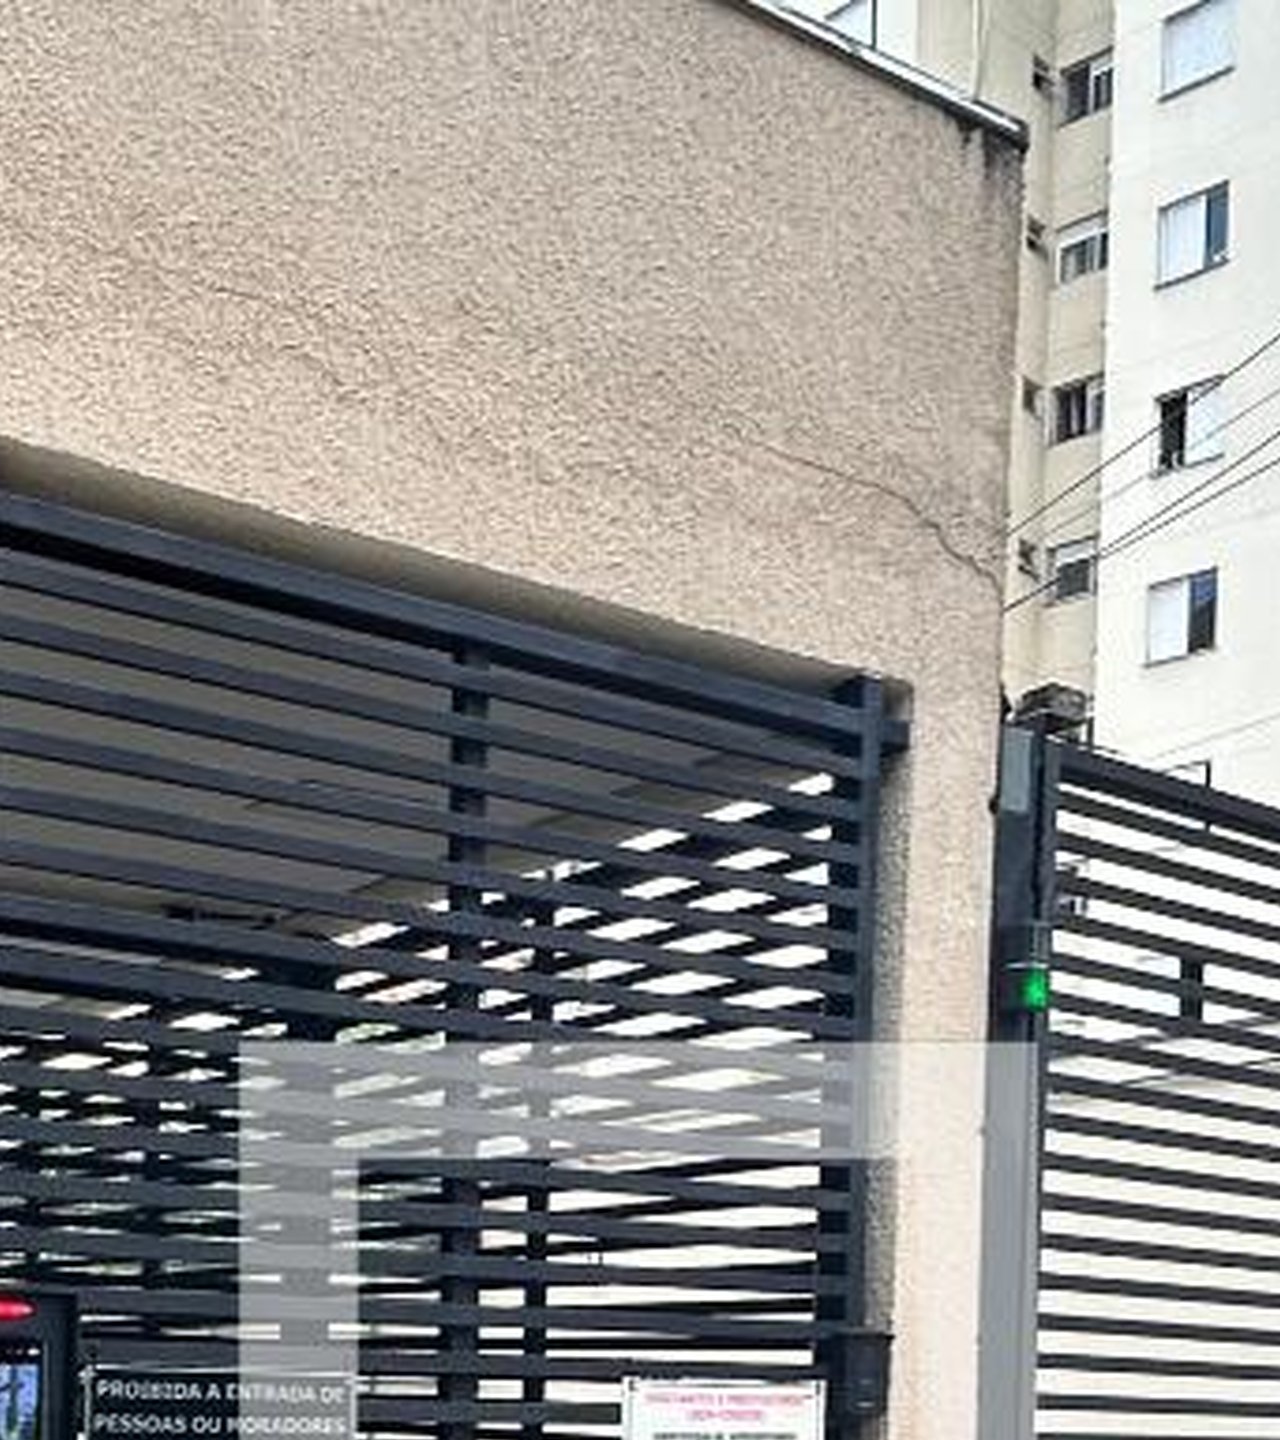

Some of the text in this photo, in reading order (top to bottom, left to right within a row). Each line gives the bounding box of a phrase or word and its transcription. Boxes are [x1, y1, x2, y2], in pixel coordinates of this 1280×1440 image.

[204, 1382, 221, 1399] A
[93, 1413, 187, 1434] PESSOAS
[190, 1415, 222, 1434] OU
